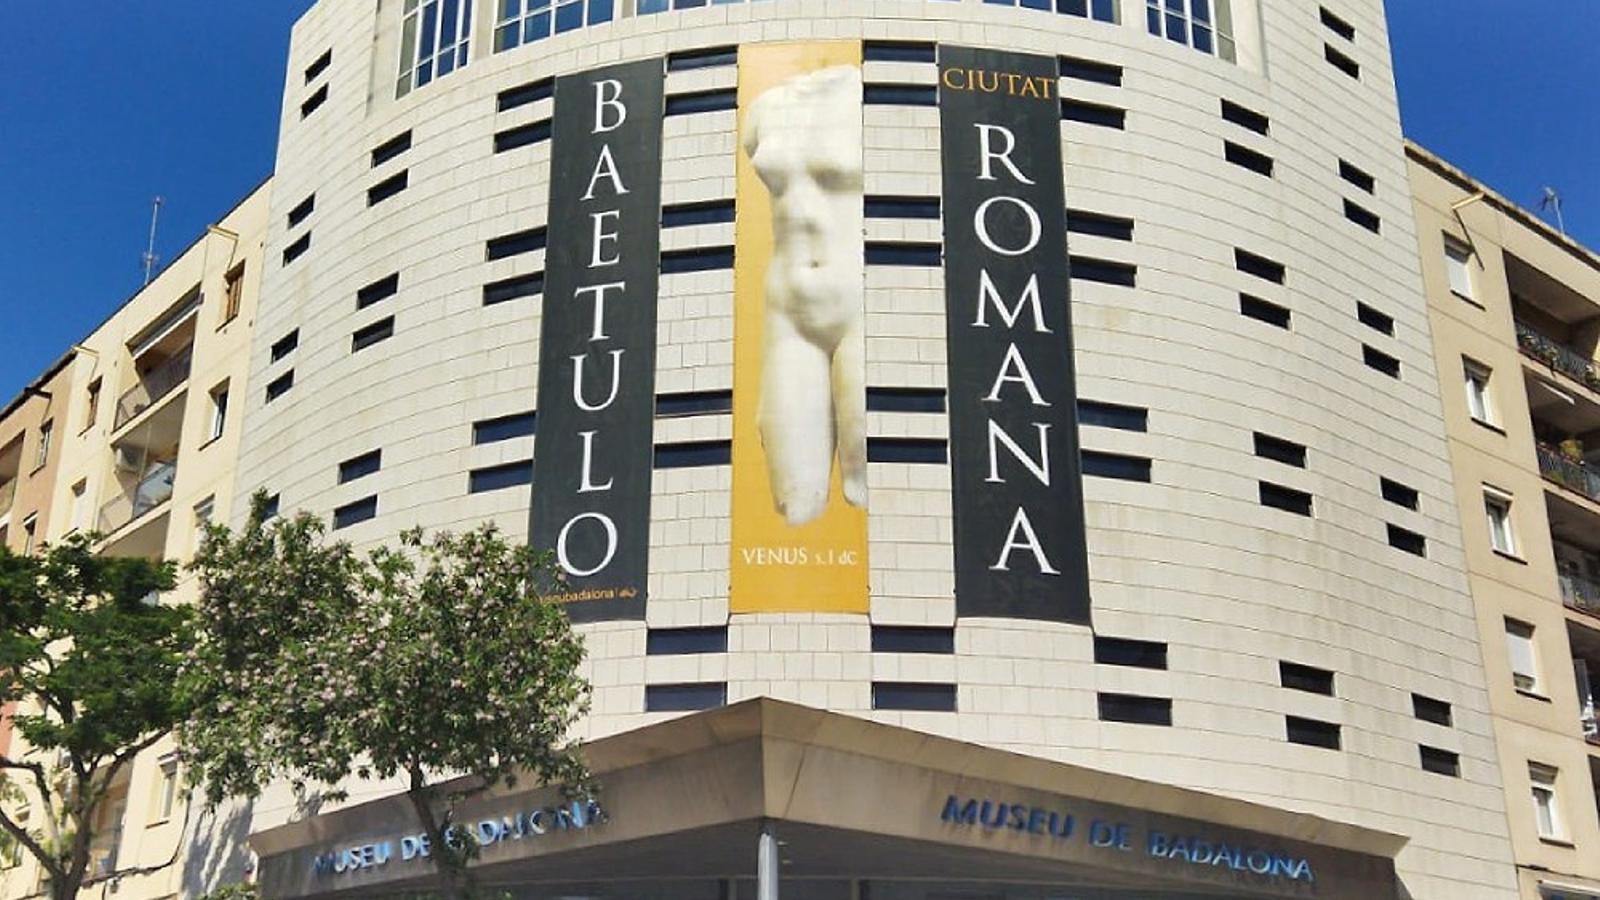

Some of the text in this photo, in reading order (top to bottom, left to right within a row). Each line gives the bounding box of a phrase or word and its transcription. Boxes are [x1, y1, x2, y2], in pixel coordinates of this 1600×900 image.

[943, 67, 1056, 99] CIUTAT
[556, 78, 630, 577] BAETULO
[971, 122, 1061, 575] ROMANA
[742, 546, 808, 566] VENUS
[311, 839, 392, 877] MUSEU
[401, 831, 430, 862] DE
[940, 793, 1315, 883] MUSEU DE BADALONA
